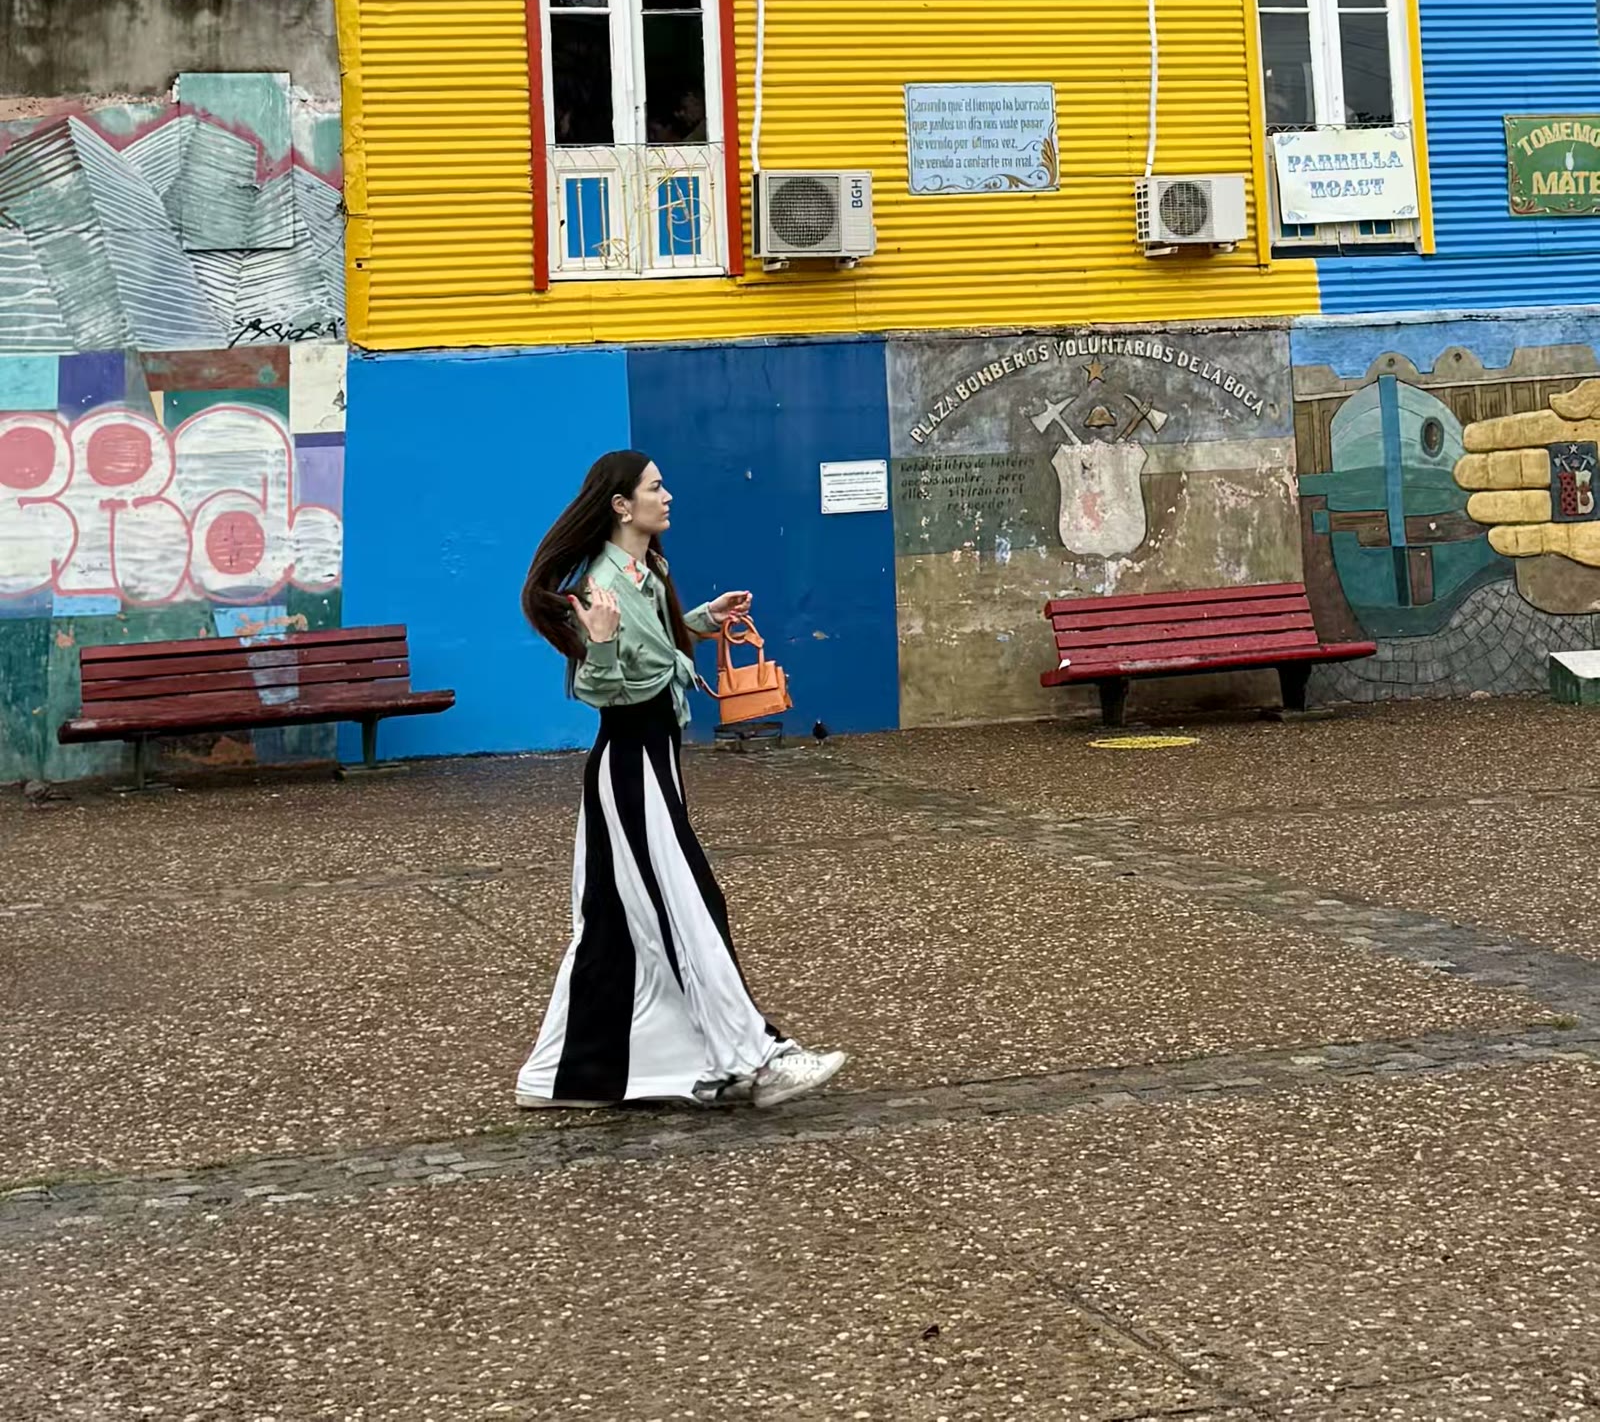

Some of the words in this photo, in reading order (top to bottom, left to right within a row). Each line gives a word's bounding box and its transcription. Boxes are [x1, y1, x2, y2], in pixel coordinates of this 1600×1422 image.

[1014, 96, 1050, 112] borrado
[1288, 151, 1403, 173] PARRILLA
[851, 179, 863, 208] BGH
[1310, 178, 1385, 198] ROAST
[1532, 171, 1600, 195] MATE
[910, 395, 958, 444] PLAZA
[955, 344, 1049, 400] BOMBEROS
[1053, 337, 1174, 364] VOLUNTARIOS
[1176, 350, 1201, 373] DE
[1201, 362, 1221, 386] LA
[1223, 375, 1264, 417] BOCA
